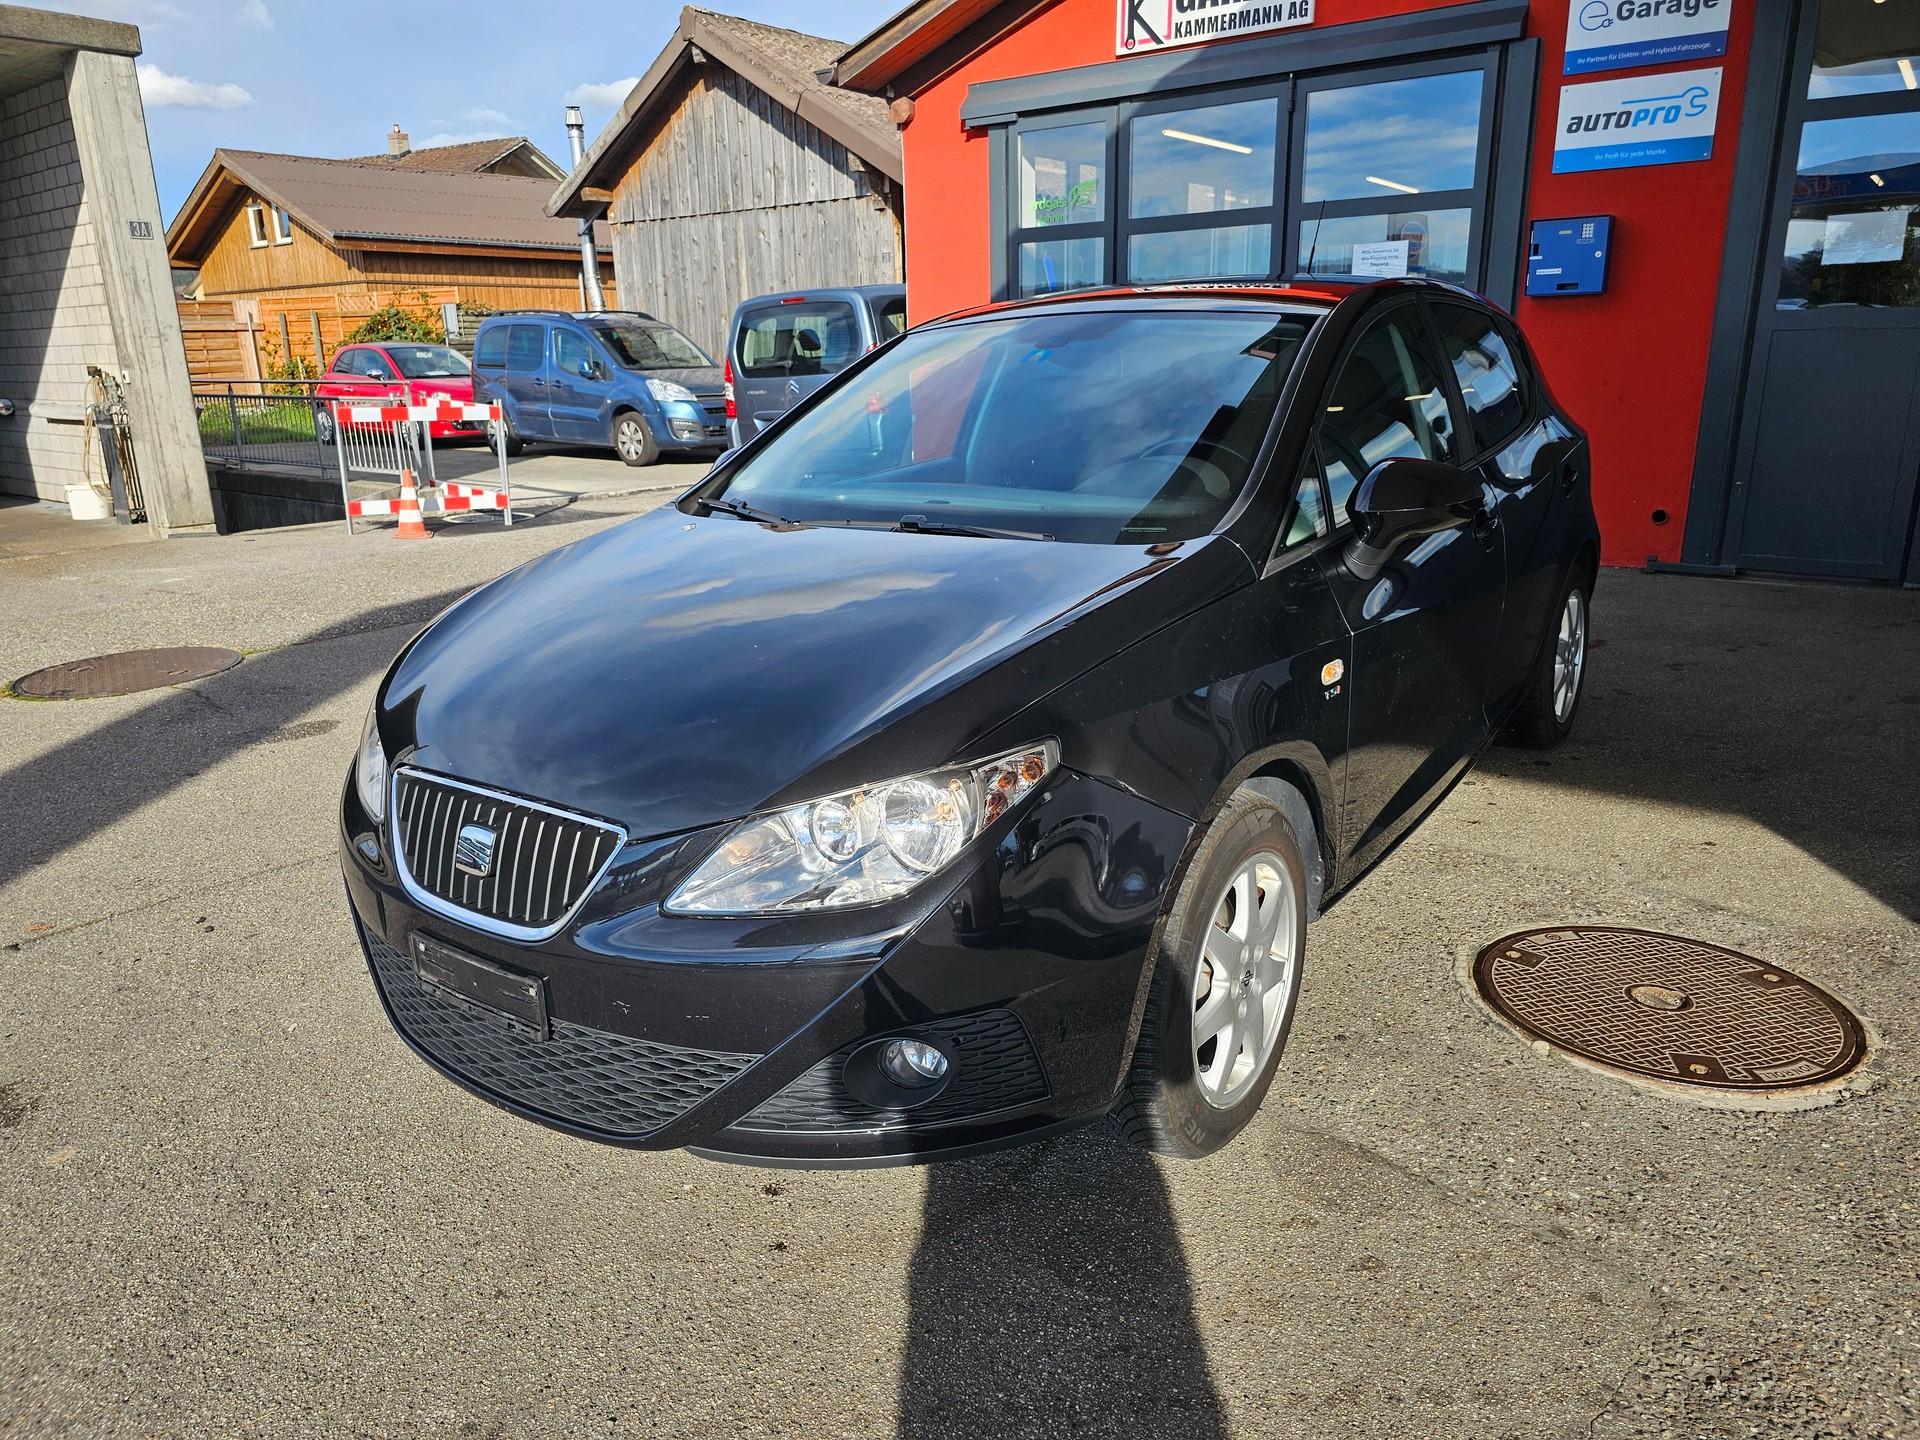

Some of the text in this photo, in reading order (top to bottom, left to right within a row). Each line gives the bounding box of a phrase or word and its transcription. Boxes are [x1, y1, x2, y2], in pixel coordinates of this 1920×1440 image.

[1616, 0, 1719, 21] Garage
[1174, 1, 1309, 39] KAMMERMANN AG
[1617, 51, 1641, 59] Elektro-
[133, 222, 149, 237] 3A
